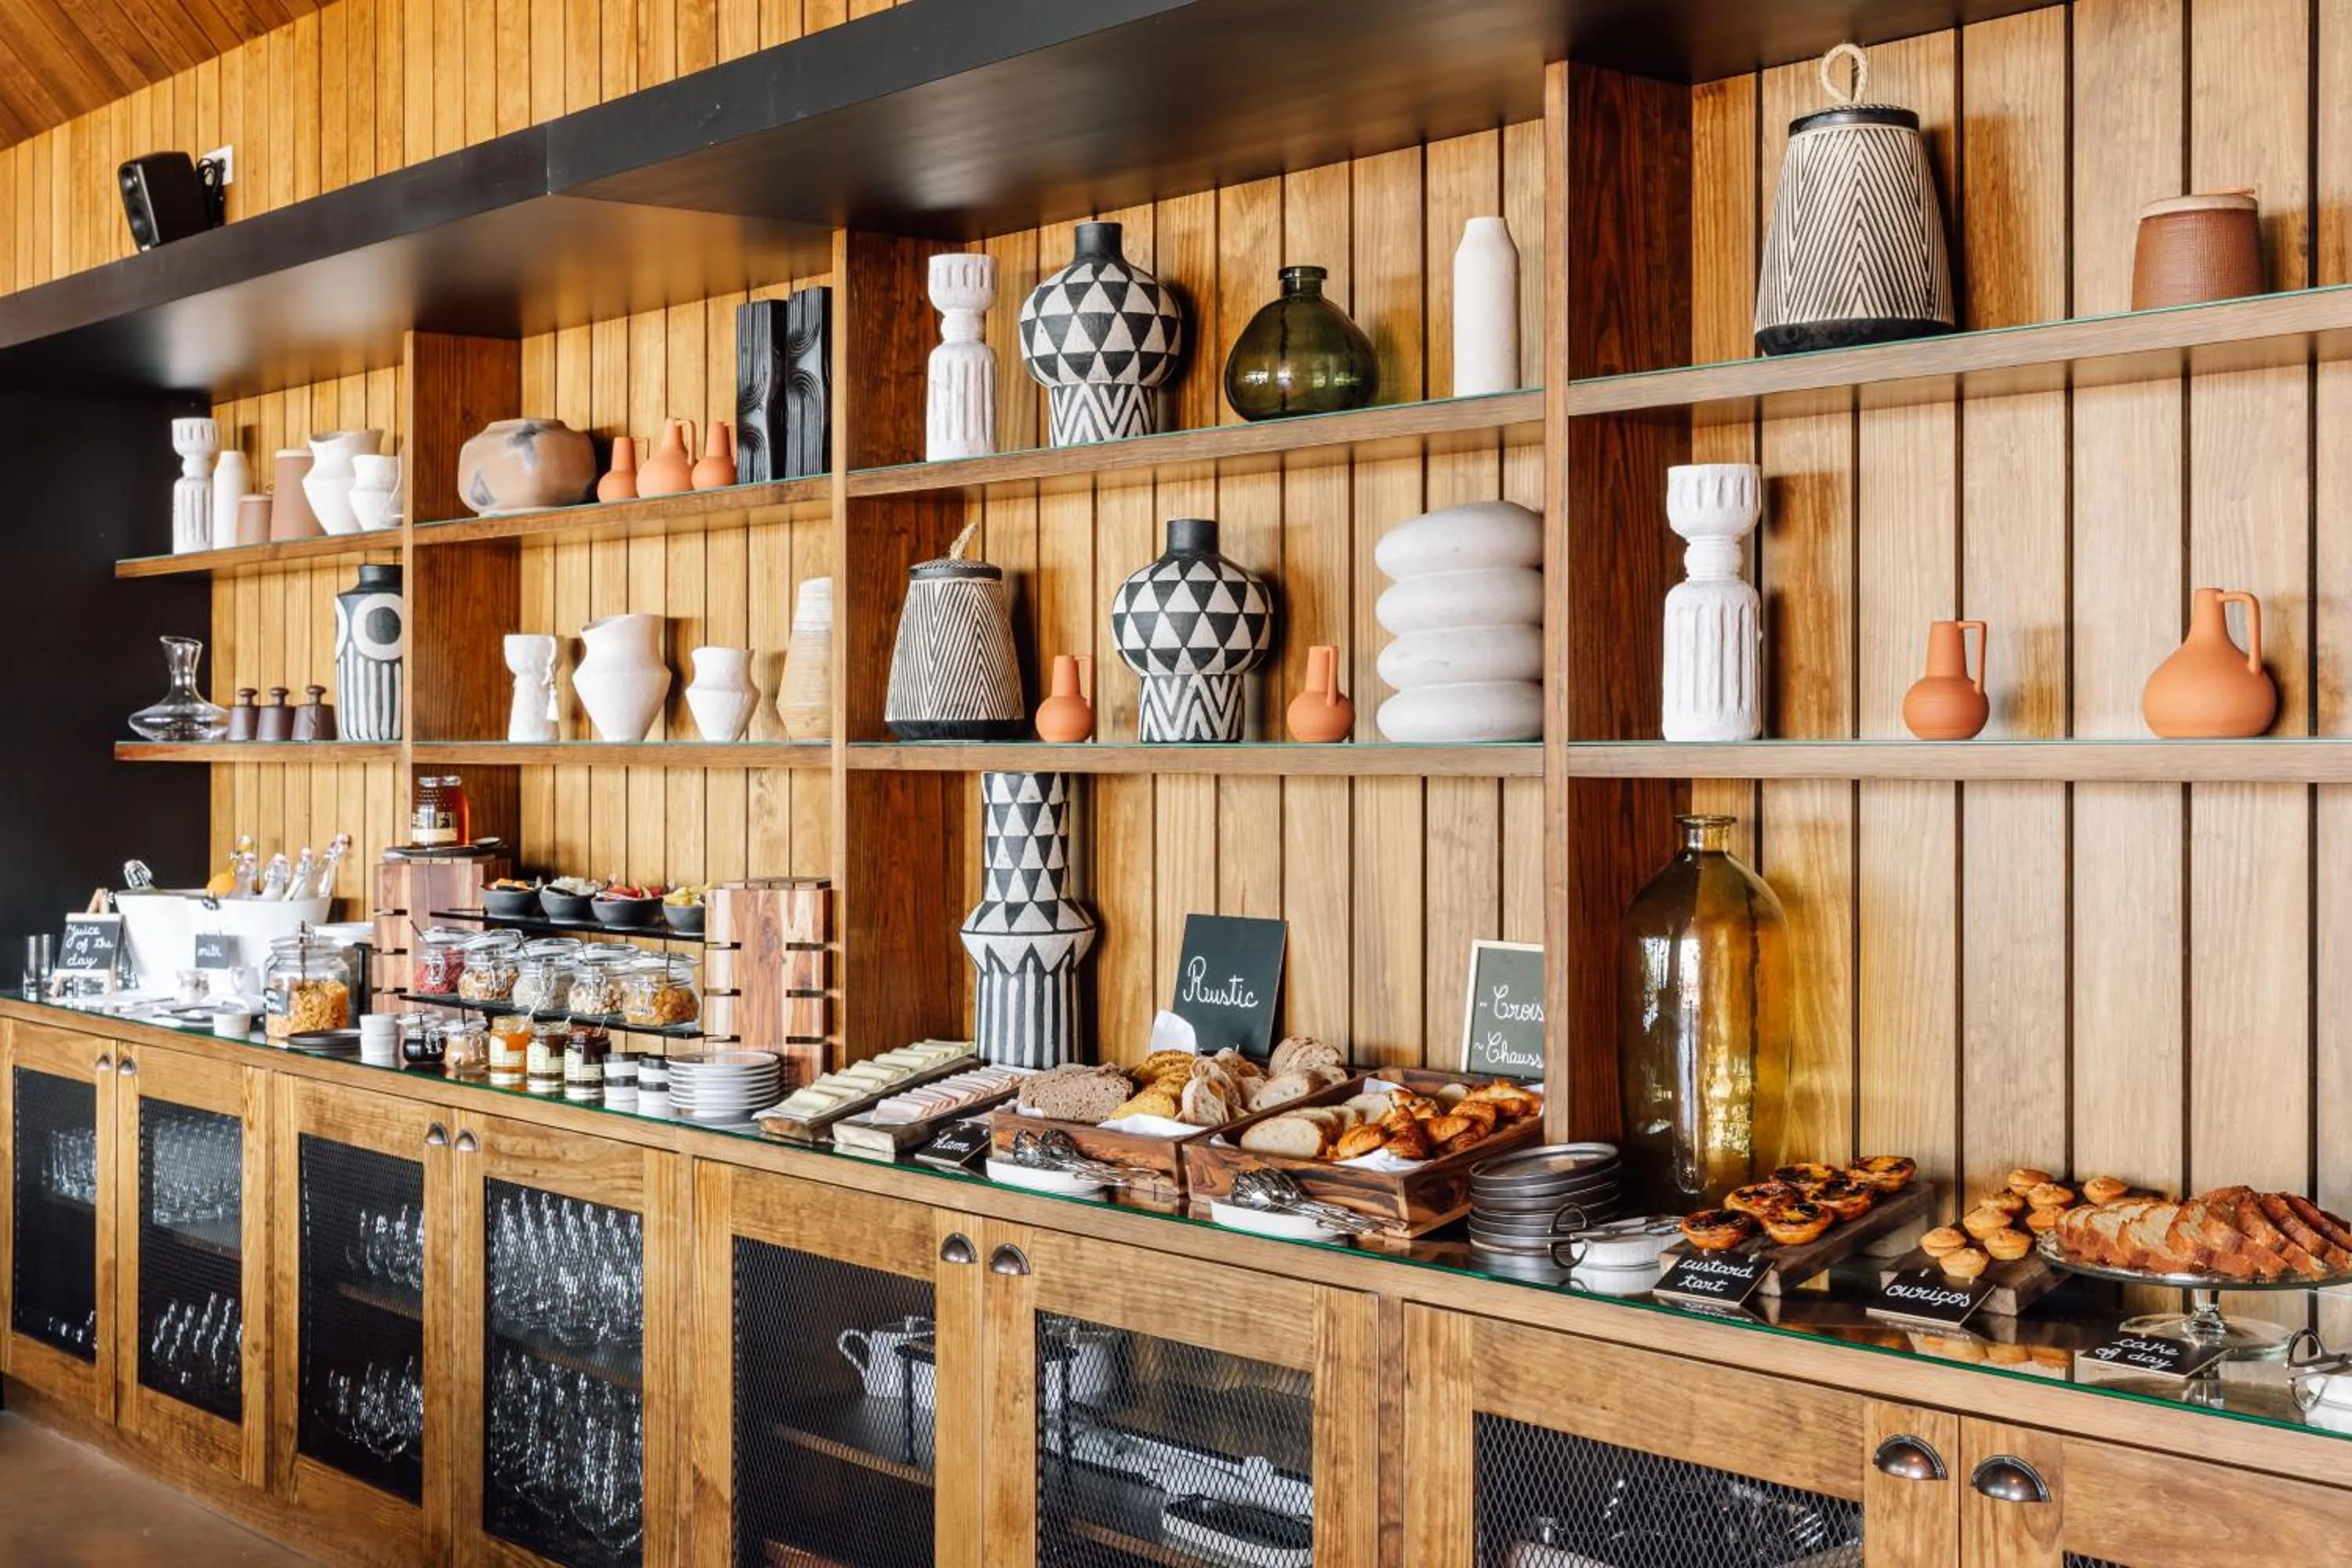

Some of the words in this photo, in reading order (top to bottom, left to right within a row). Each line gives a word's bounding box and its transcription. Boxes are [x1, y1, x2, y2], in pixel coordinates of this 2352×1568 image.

[76, 937, 89, 954] of
[93, 936, 114, 949] the
[66, 953, 98, 970] day
[1182, 955, 1258, 1008] Rustic
[1679, 1259, 1755, 1279] custard
[1678, 1274, 1729, 1292] tart
[1886, 1284, 1971, 1308] ouriços
[2111, 1338, 2180, 1356] cake
[2095, 1348, 2122, 1360] of
[2126, 1352, 2174, 1370] day
